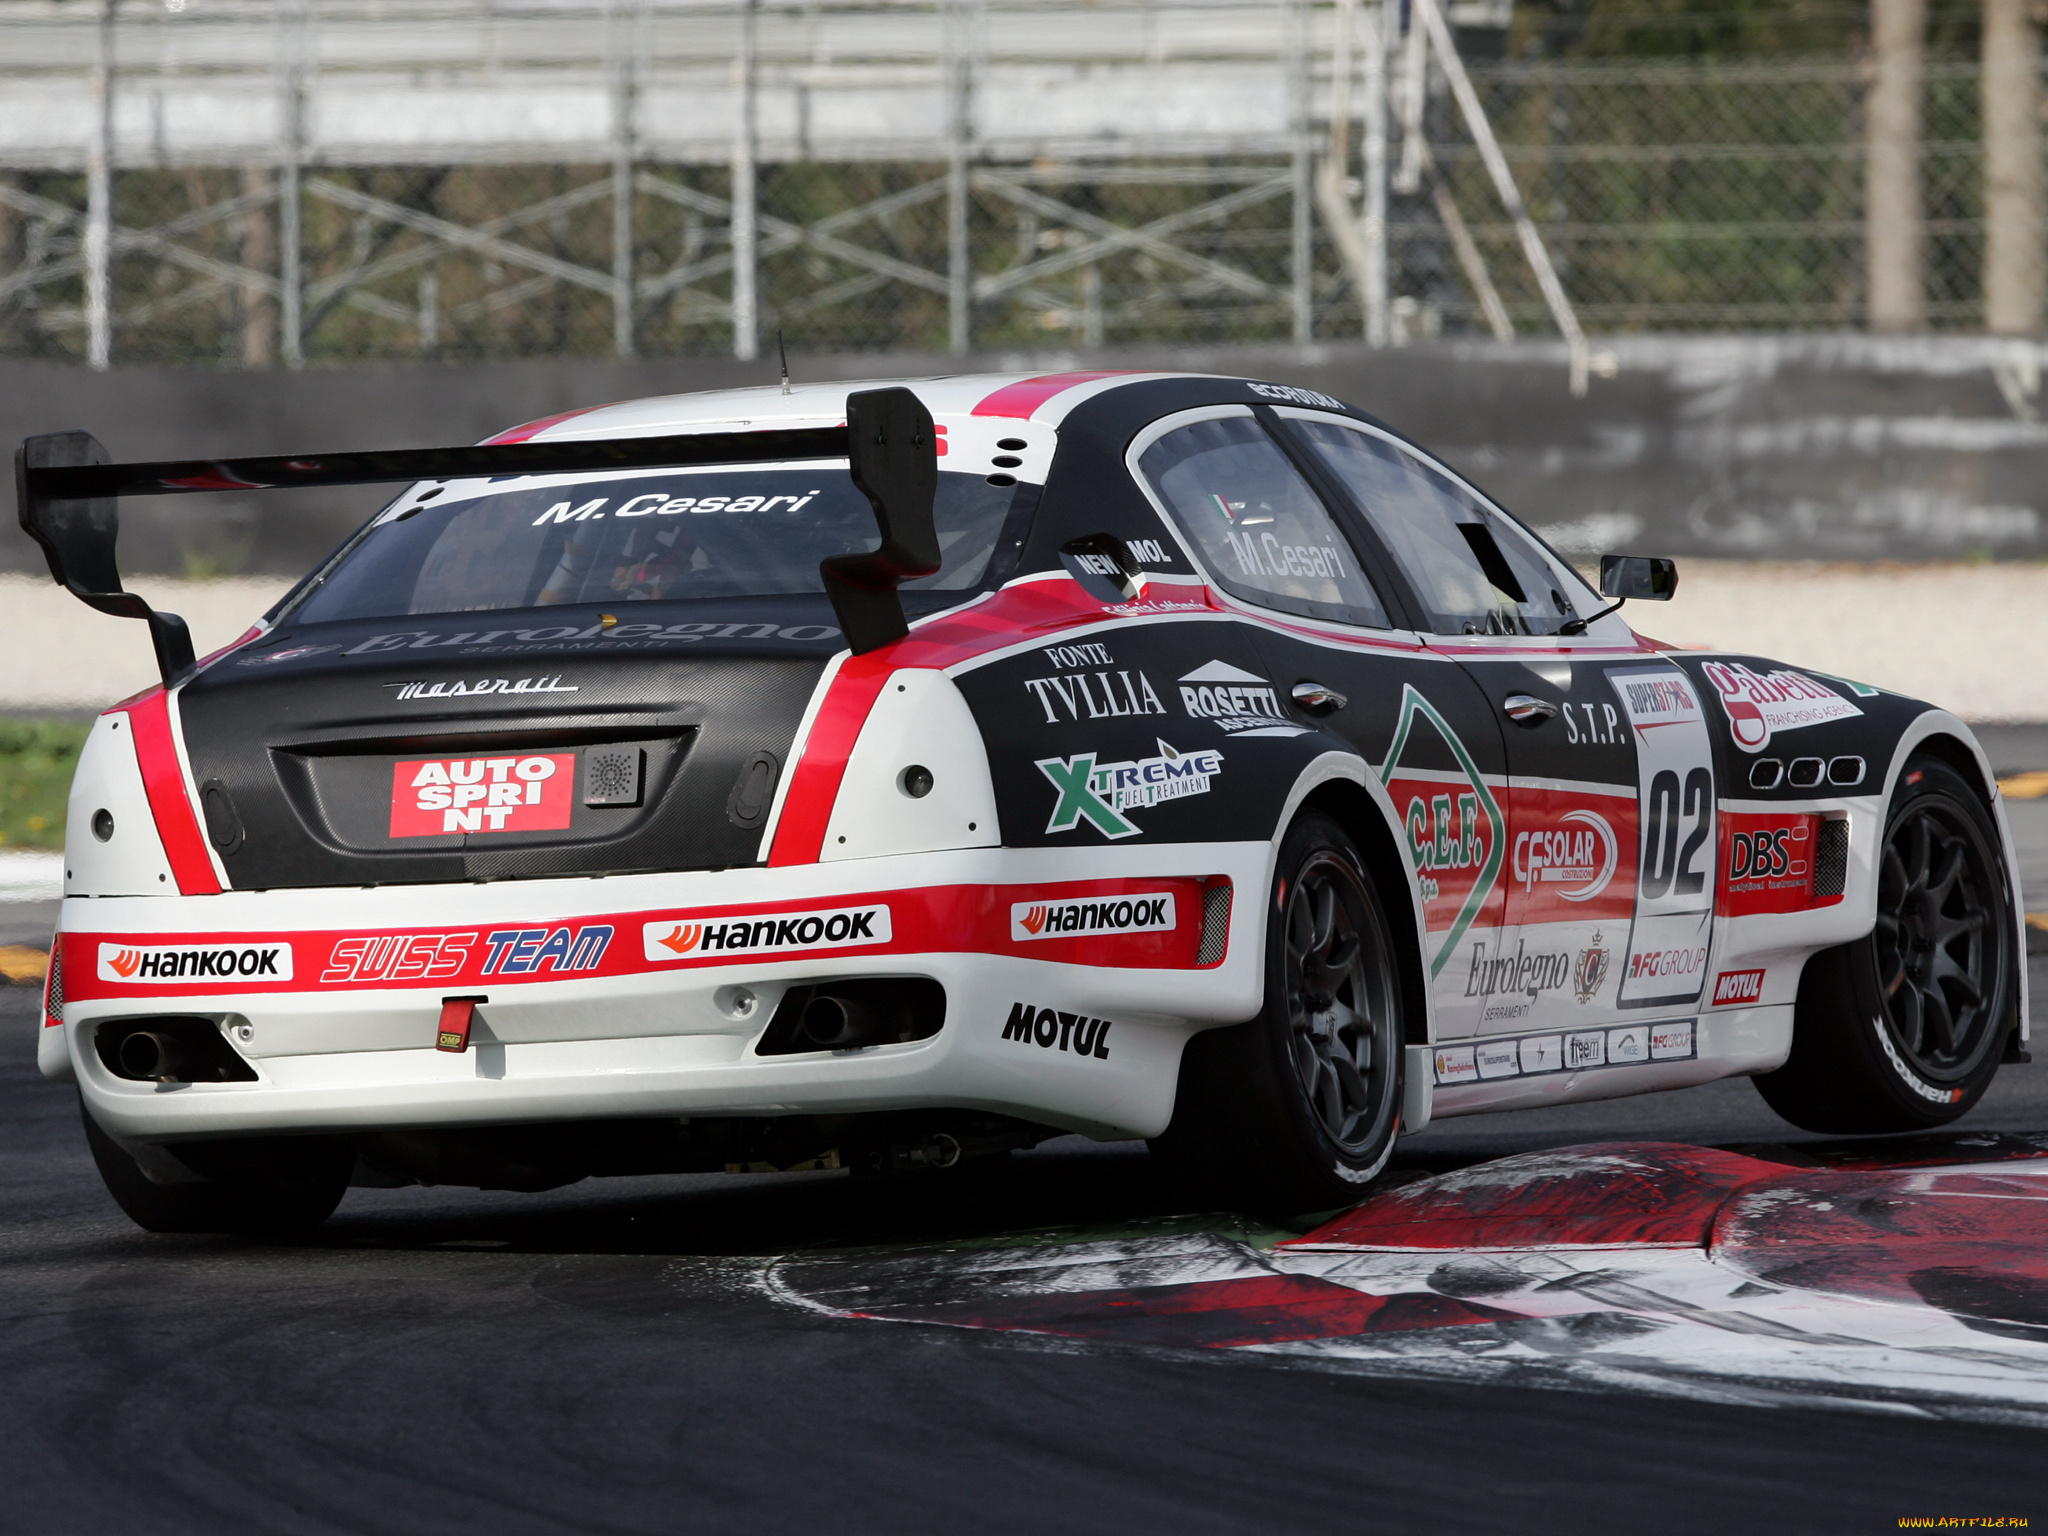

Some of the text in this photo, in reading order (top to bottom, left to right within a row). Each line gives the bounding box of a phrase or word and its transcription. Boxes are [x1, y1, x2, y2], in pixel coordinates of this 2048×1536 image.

[532, 490, 821, 526] M. Cesari
[1073, 539, 1172, 575] NEW MOL
[1044, 643, 1114, 669] FONTE
[1179, 686, 1285, 718] ROSETTI
[1563, 702, 1626, 745] S.T.P.
[411, 757, 556, 787] AUTO
[416, 781, 542, 811] SPRI
[443, 806, 514, 832] NT
[1642, 767, 1712, 900] 02
[1730, 829, 1789, 880] DBS
[320, 925, 615, 983] SWISS TEAM
[1464, 938, 1570, 1005] Eurolegno
[1716, 970, 1761, 1001] MOTUL
[1484, 1004, 1530, 1021] SERRAMENTI
[440, 1035, 461, 1045] OMP
[1001, 1003, 1112, 1060] MOTUL
